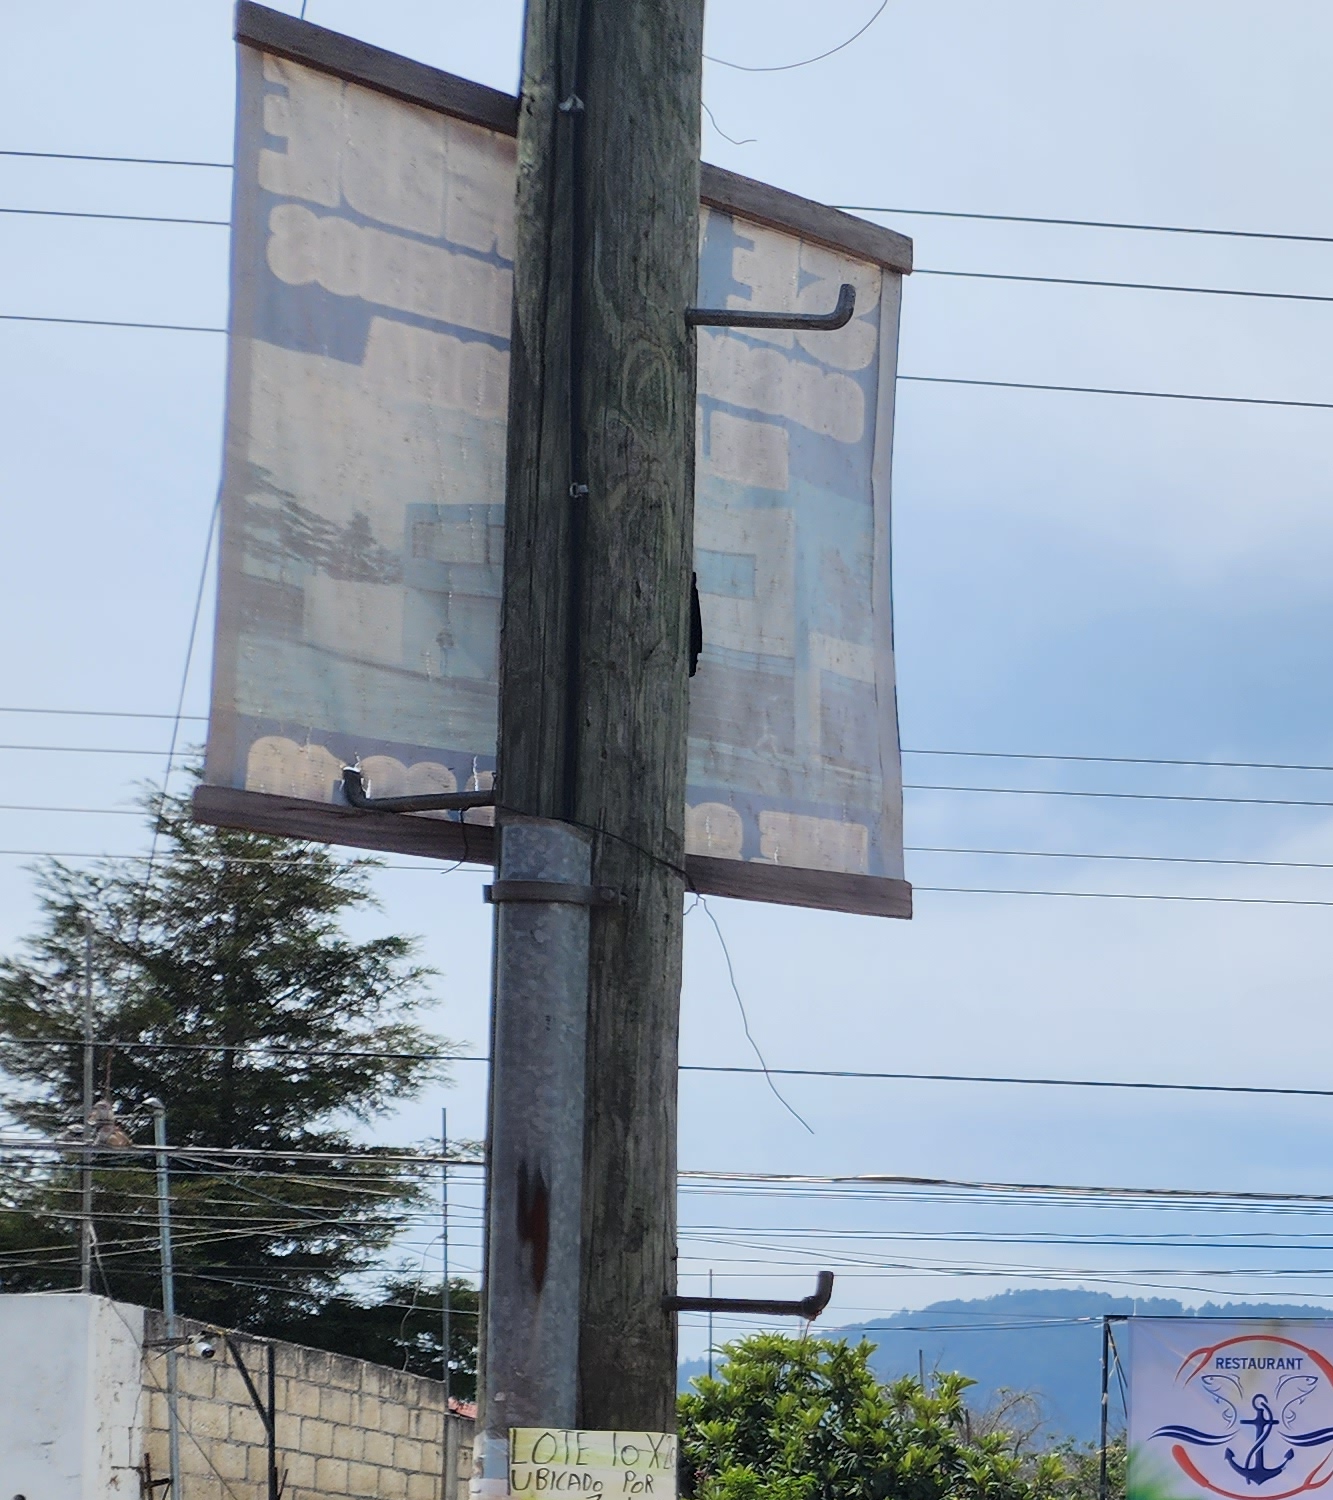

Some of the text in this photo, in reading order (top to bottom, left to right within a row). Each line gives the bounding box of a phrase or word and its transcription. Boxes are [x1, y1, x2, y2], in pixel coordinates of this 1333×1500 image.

[1215, 1357, 1304, 1370] RESTAURANT
[510, 1428, 590, 1466] LOTE
[511, 1468, 654, 1494] UBICADO POR
